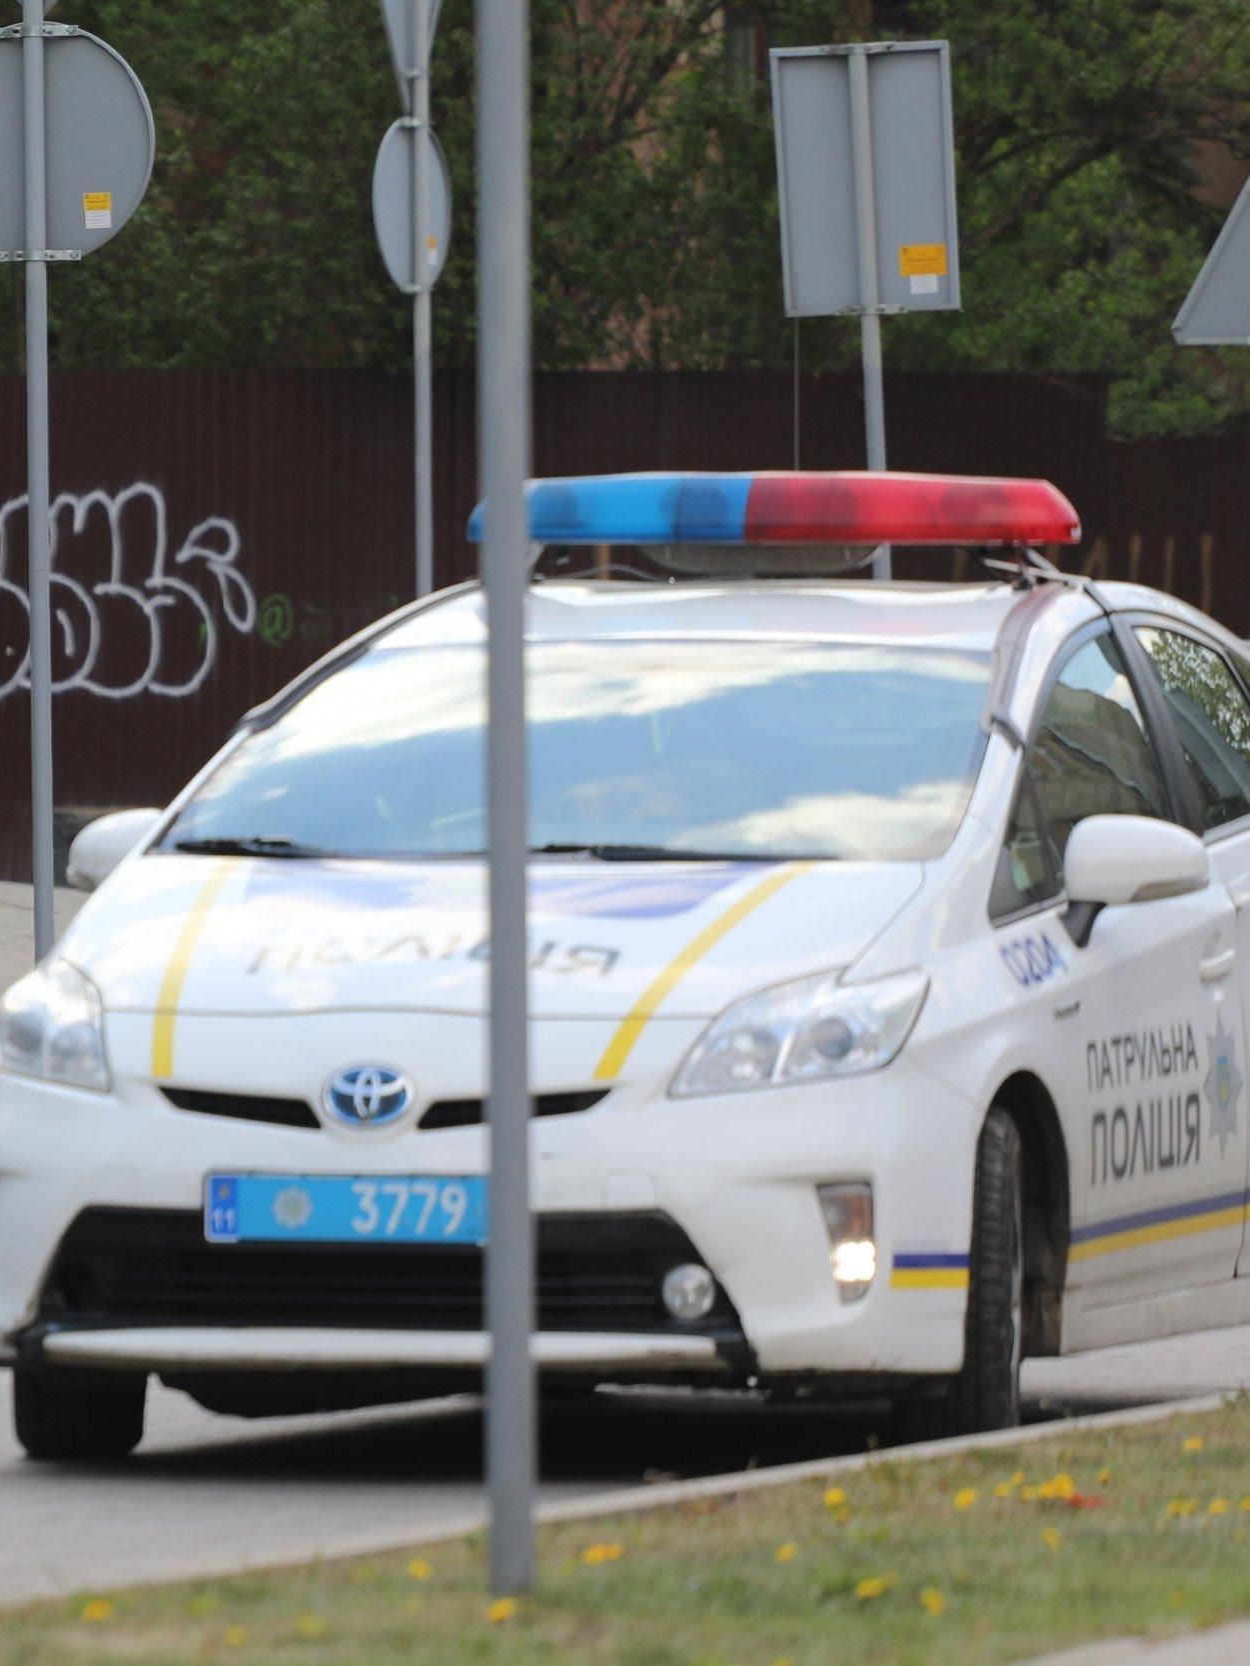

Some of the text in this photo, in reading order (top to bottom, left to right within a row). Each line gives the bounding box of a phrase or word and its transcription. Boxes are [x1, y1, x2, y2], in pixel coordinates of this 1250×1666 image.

[1085, 1024, 1199, 1092] ПАТРУЛЬНА
[1090, 1093, 1200, 1187] ПОЛІЦІЯ
[211, 1183, 468, 1235] 11 3779
